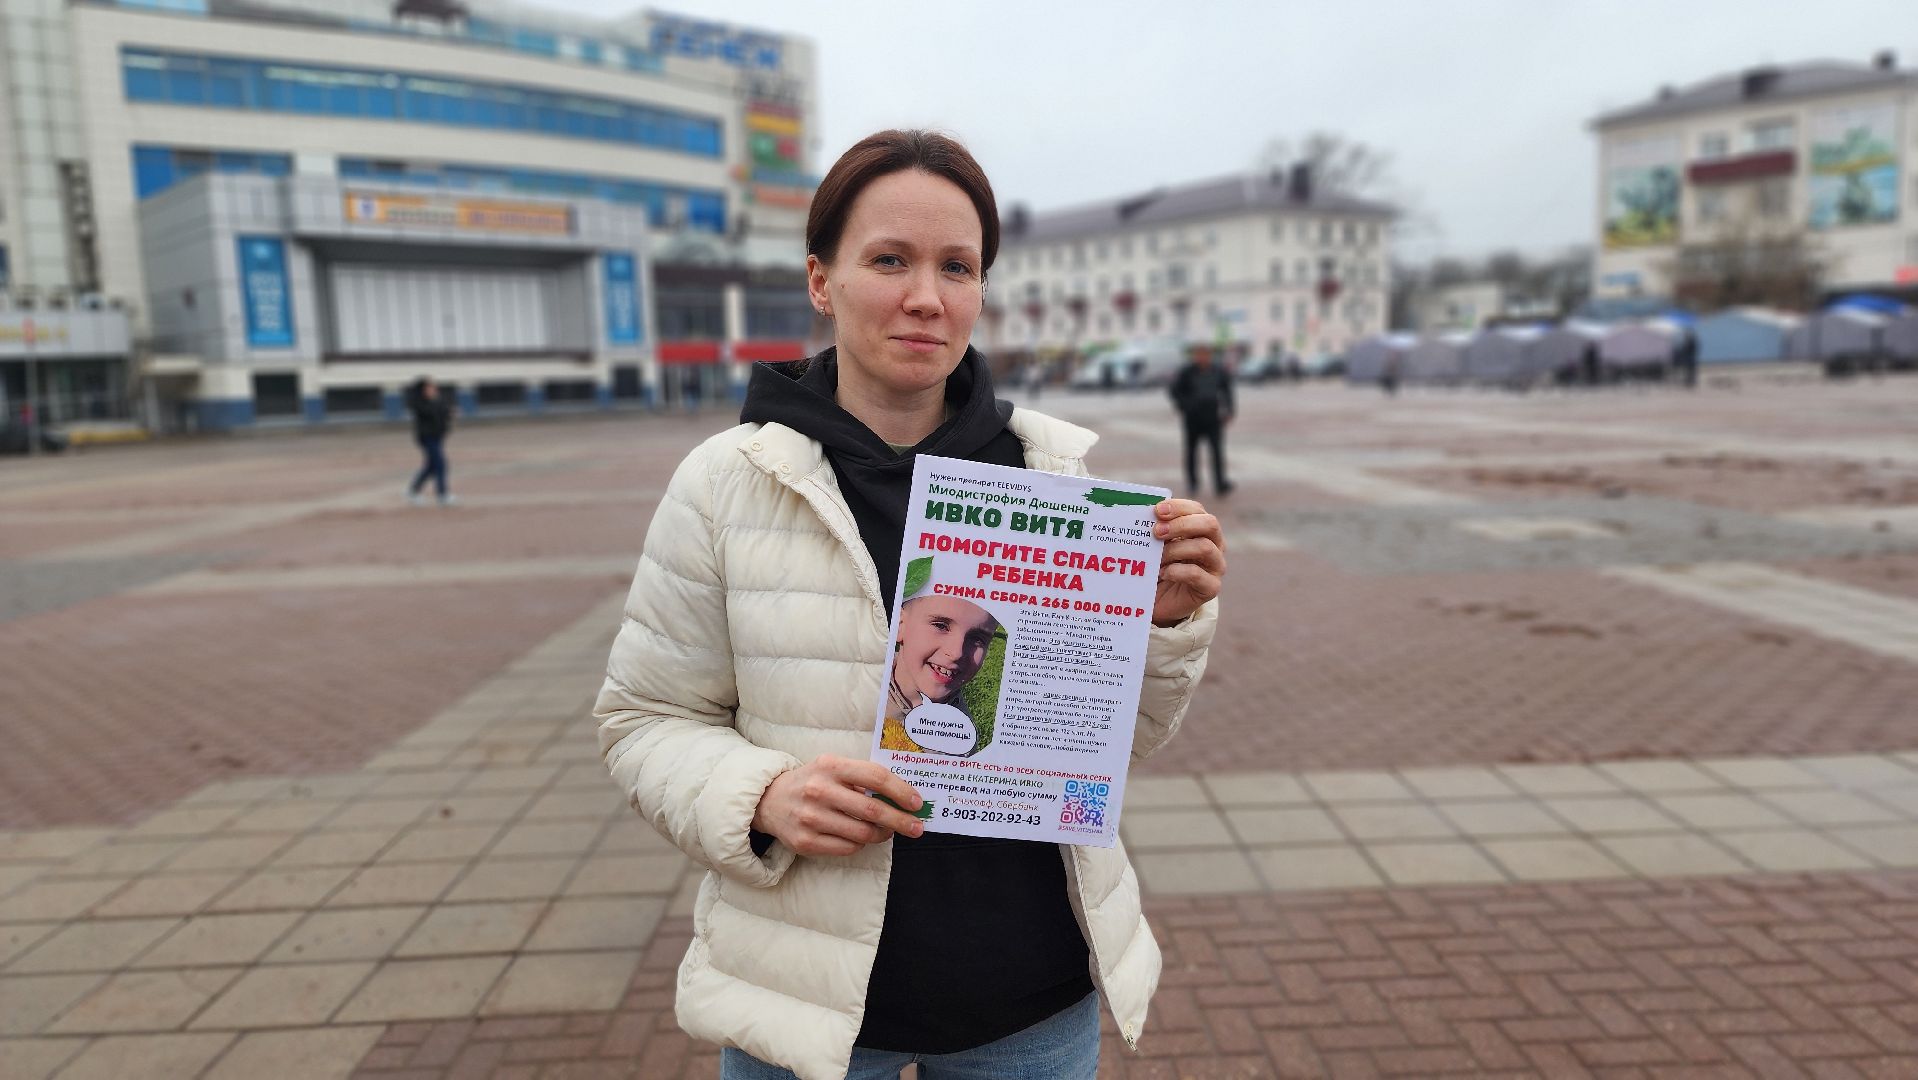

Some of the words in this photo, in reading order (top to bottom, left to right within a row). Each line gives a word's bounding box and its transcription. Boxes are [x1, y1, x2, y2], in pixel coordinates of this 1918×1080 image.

[930, 472, 956, 482] Нужен
[928, 484, 1026, 506] Миодистрофия
[1028, 498, 1089, 514] Дюшенна
[925, 500, 1002, 528] ИВКО
[1010, 511, 1084, 540] ВИТЯ
[1140, 520, 1155, 528] ЛЕТ
[919, 532, 1046, 564] ПОМОГИТЕ
[1052, 550, 1146, 576] СПАСТИ
[977, 562, 1084, 591] РЕБЕНКА
[934, 584, 986, 599] СУММА
[990, 591, 1038, 606] СБОРА
[1042, 597, 1070, 610] 265
[1074, 600, 1100, 612] 000
[1105, 604, 1132, 616] 000
[920, 718, 936, 726] Мне
[912, 728, 934, 736] ваша
[934, 730, 970, 740] помощь!
[890, 766, 912, 776] Сбор
[914, 770, 938, 778] ведет
[968, 774, 1017, 786] ЕКАТЕРИНА
[1020, 779, 1044, 788] ИВКО
[892, 752, 949, 766] Информация
[960, 760, 981, 770] ВИТЕ
[984, 764, 1001, 772] есть
[1036, 769, 1088, 780] социальных
[1090, 774, 1112, 782] сетях
[938, 784, 978, 794] перевод
[993, 788, 1026, 798] любую
[1028, 792, 1058, 802] сумму
[942, 807, 1040, 826] 8-903-202-92-43
